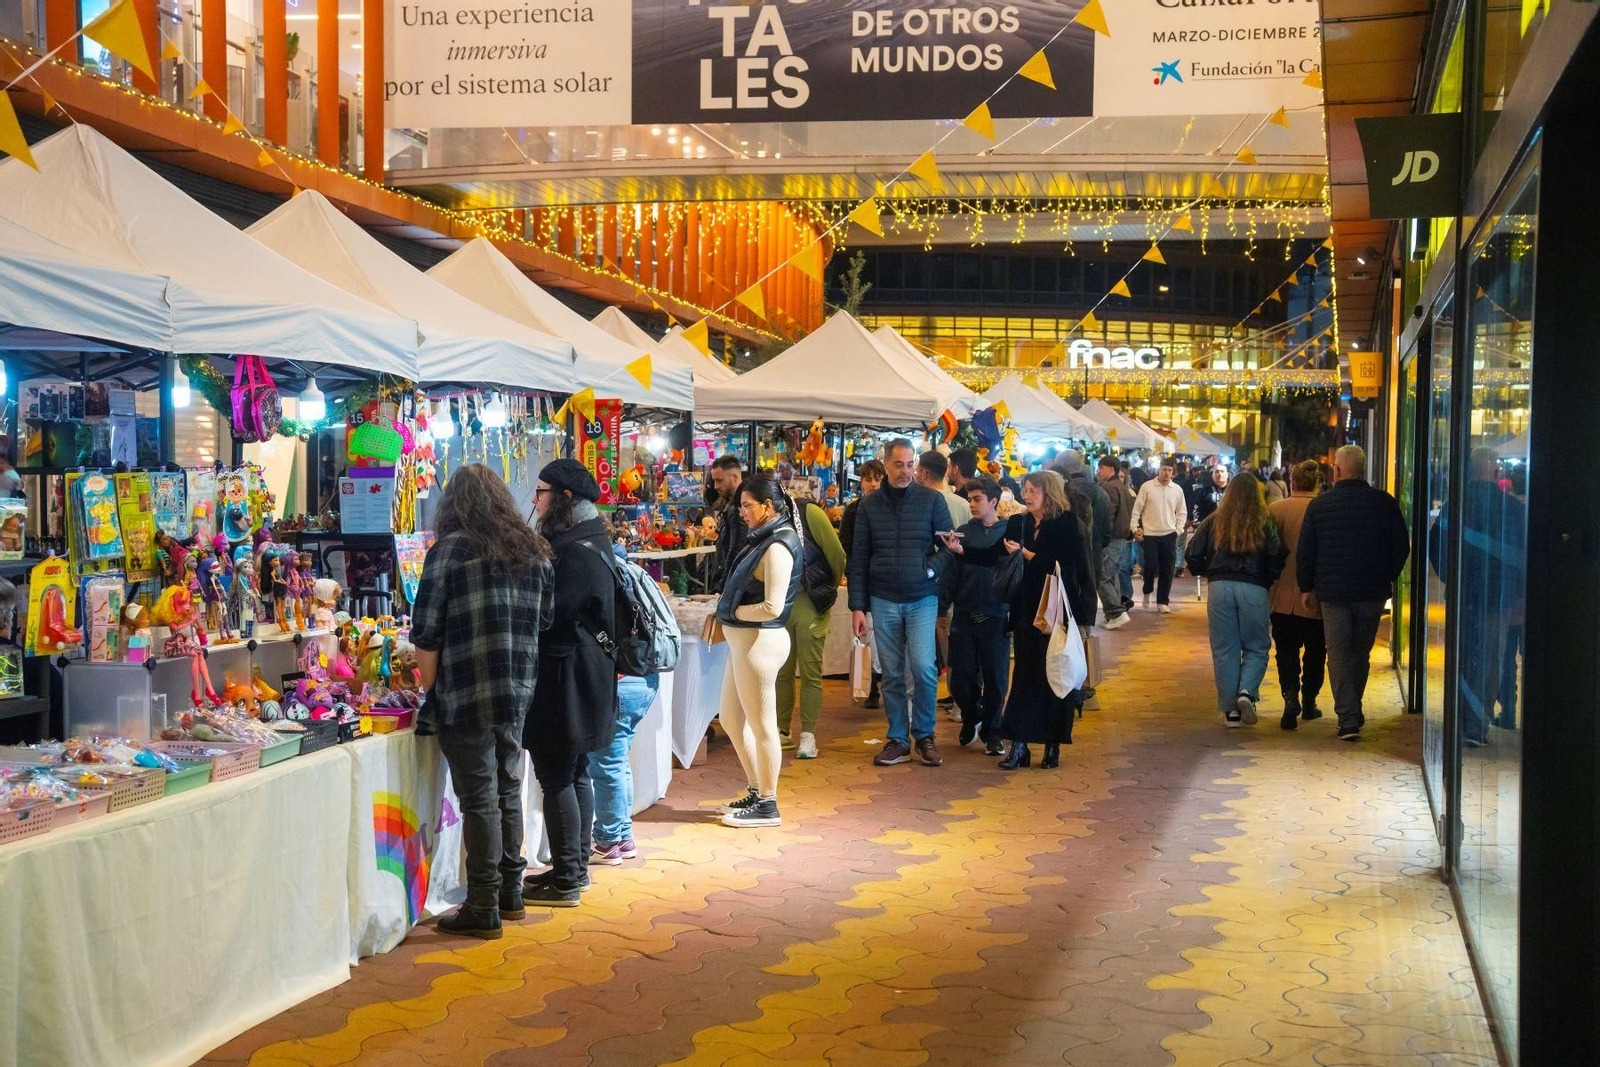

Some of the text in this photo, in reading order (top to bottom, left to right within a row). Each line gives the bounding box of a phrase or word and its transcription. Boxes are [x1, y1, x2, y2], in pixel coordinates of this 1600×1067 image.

[401, 1, 594, 29] Una experiencia
[852, 6, 1020, 38] DE OTROS
[708, 4, 794, 57] TA
[1152, 26, 1307, 43] MARZO-DICIEMBRE
[447, 38, 548, 61] inmersiva
[850, 44, 1004, 73] MUNDOS
[700, 55, 810, 110] LES
[1191, 60, 1273, 77] Fundación
[384, 71, 613, 101] por el sistema solar
[1391, 150, 1440, 186] JD
[1068, 339, 1160, 370] fnac
[350, 413, 364, 424] 15
[585, 422, 602, 434] 18
